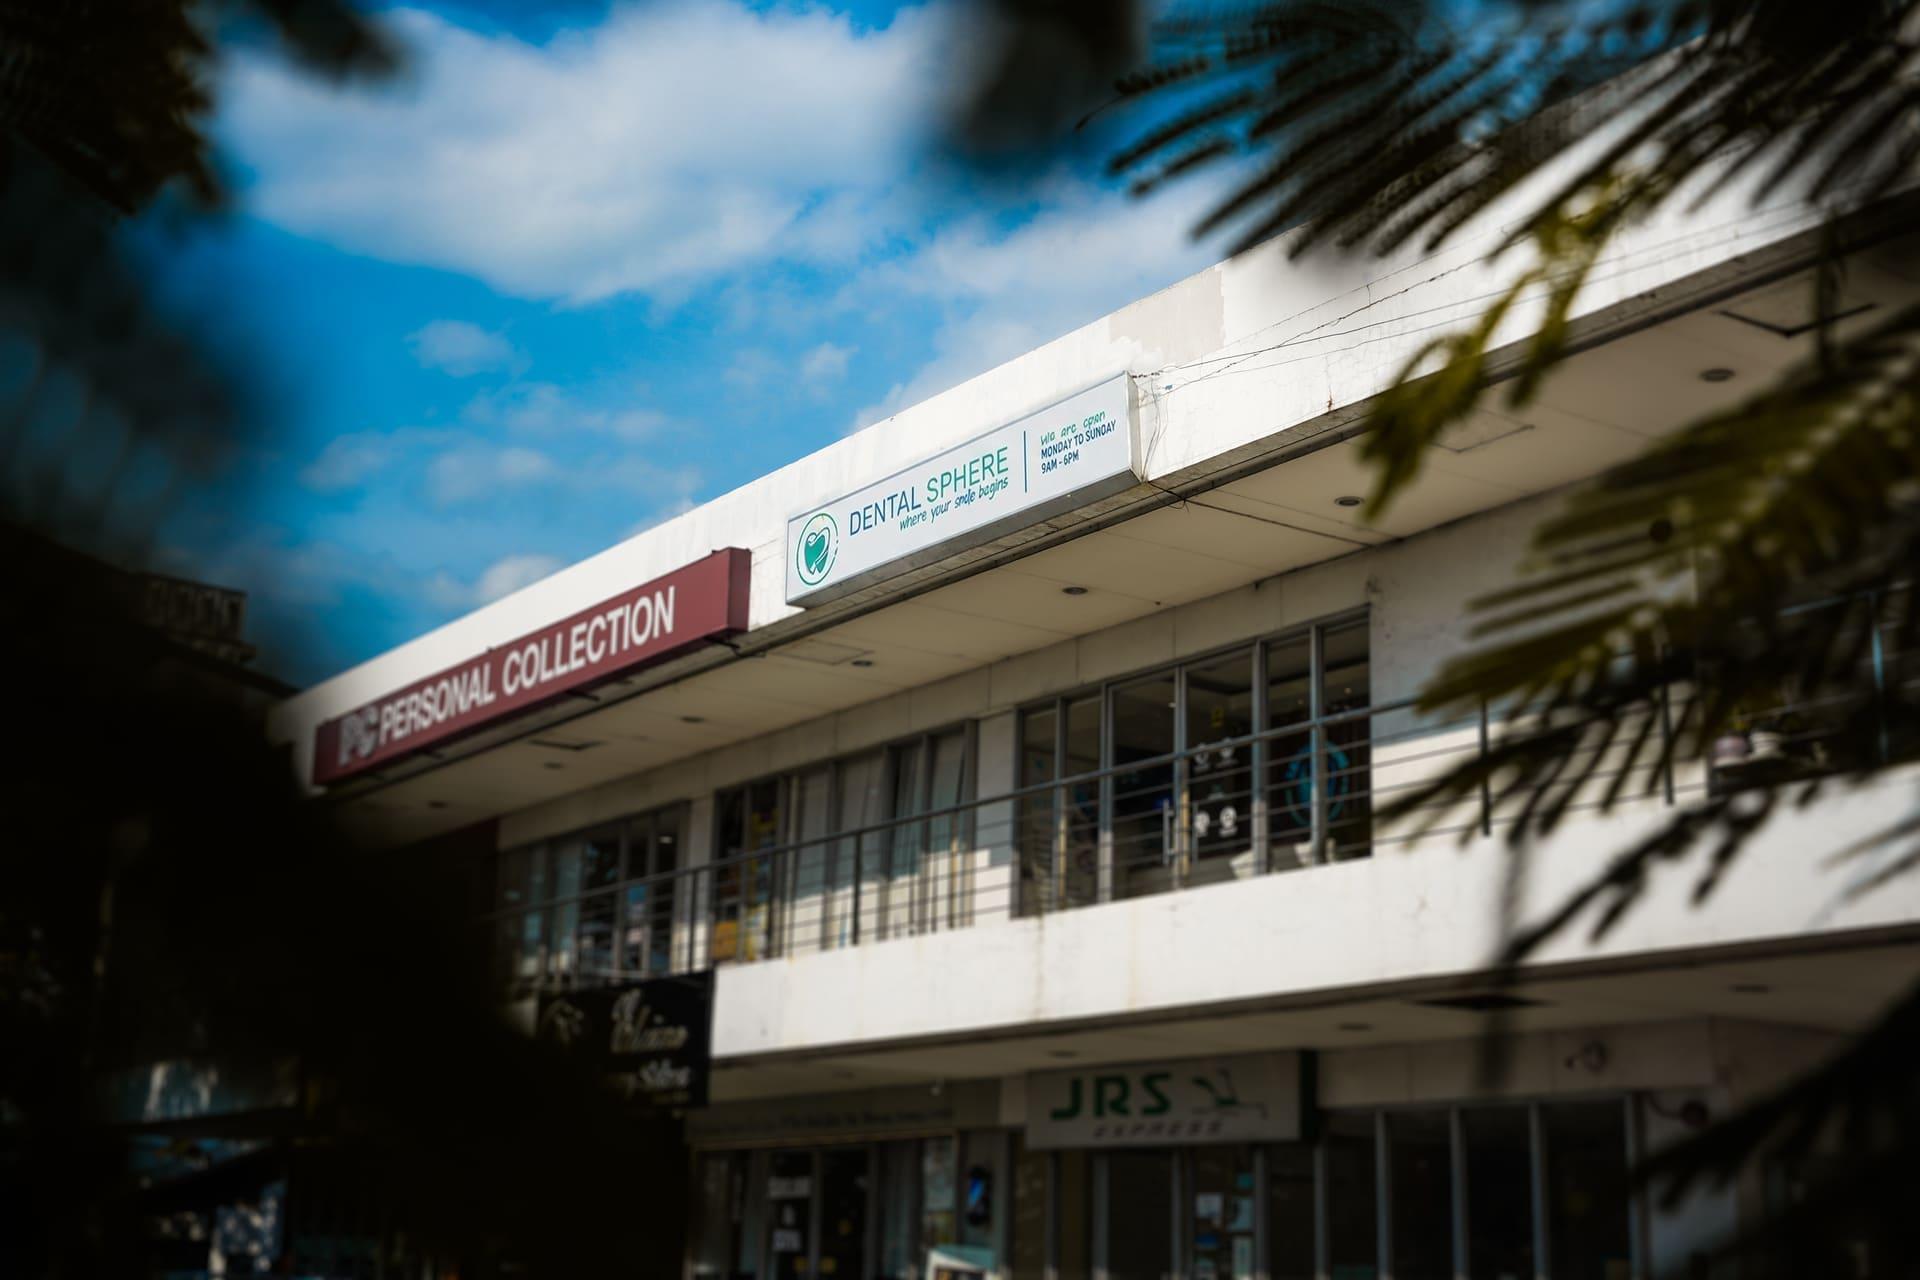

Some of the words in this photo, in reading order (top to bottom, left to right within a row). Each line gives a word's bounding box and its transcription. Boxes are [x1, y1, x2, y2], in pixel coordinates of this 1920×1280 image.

[1041, 438, 1073, 460] MONDAY
[1074, 433, 1084, 447] TO
[1085, 419, 1117, 442] SUNDAY
[1083, 411, 1106, 429] open
[1041, 458, 1058, 475] 9AM
[1063, 449, 1080, 466] 6PM
[849, 486, 922, 536] DENTAL
[926, 446, 1009, 503] SPHERE
[900, 508, 927, 531] where
[930, 499, 952, 524] your
[954, 489, 976, 510] smile
[978, 476, 1009, 500] begins
[338, 703, 380, 767] PC
[378, 662, 497, 746] PERSONAL
[502, 585, 677, 696] COLLECTION
[1049, 1071, 1174, 1121] JRS
